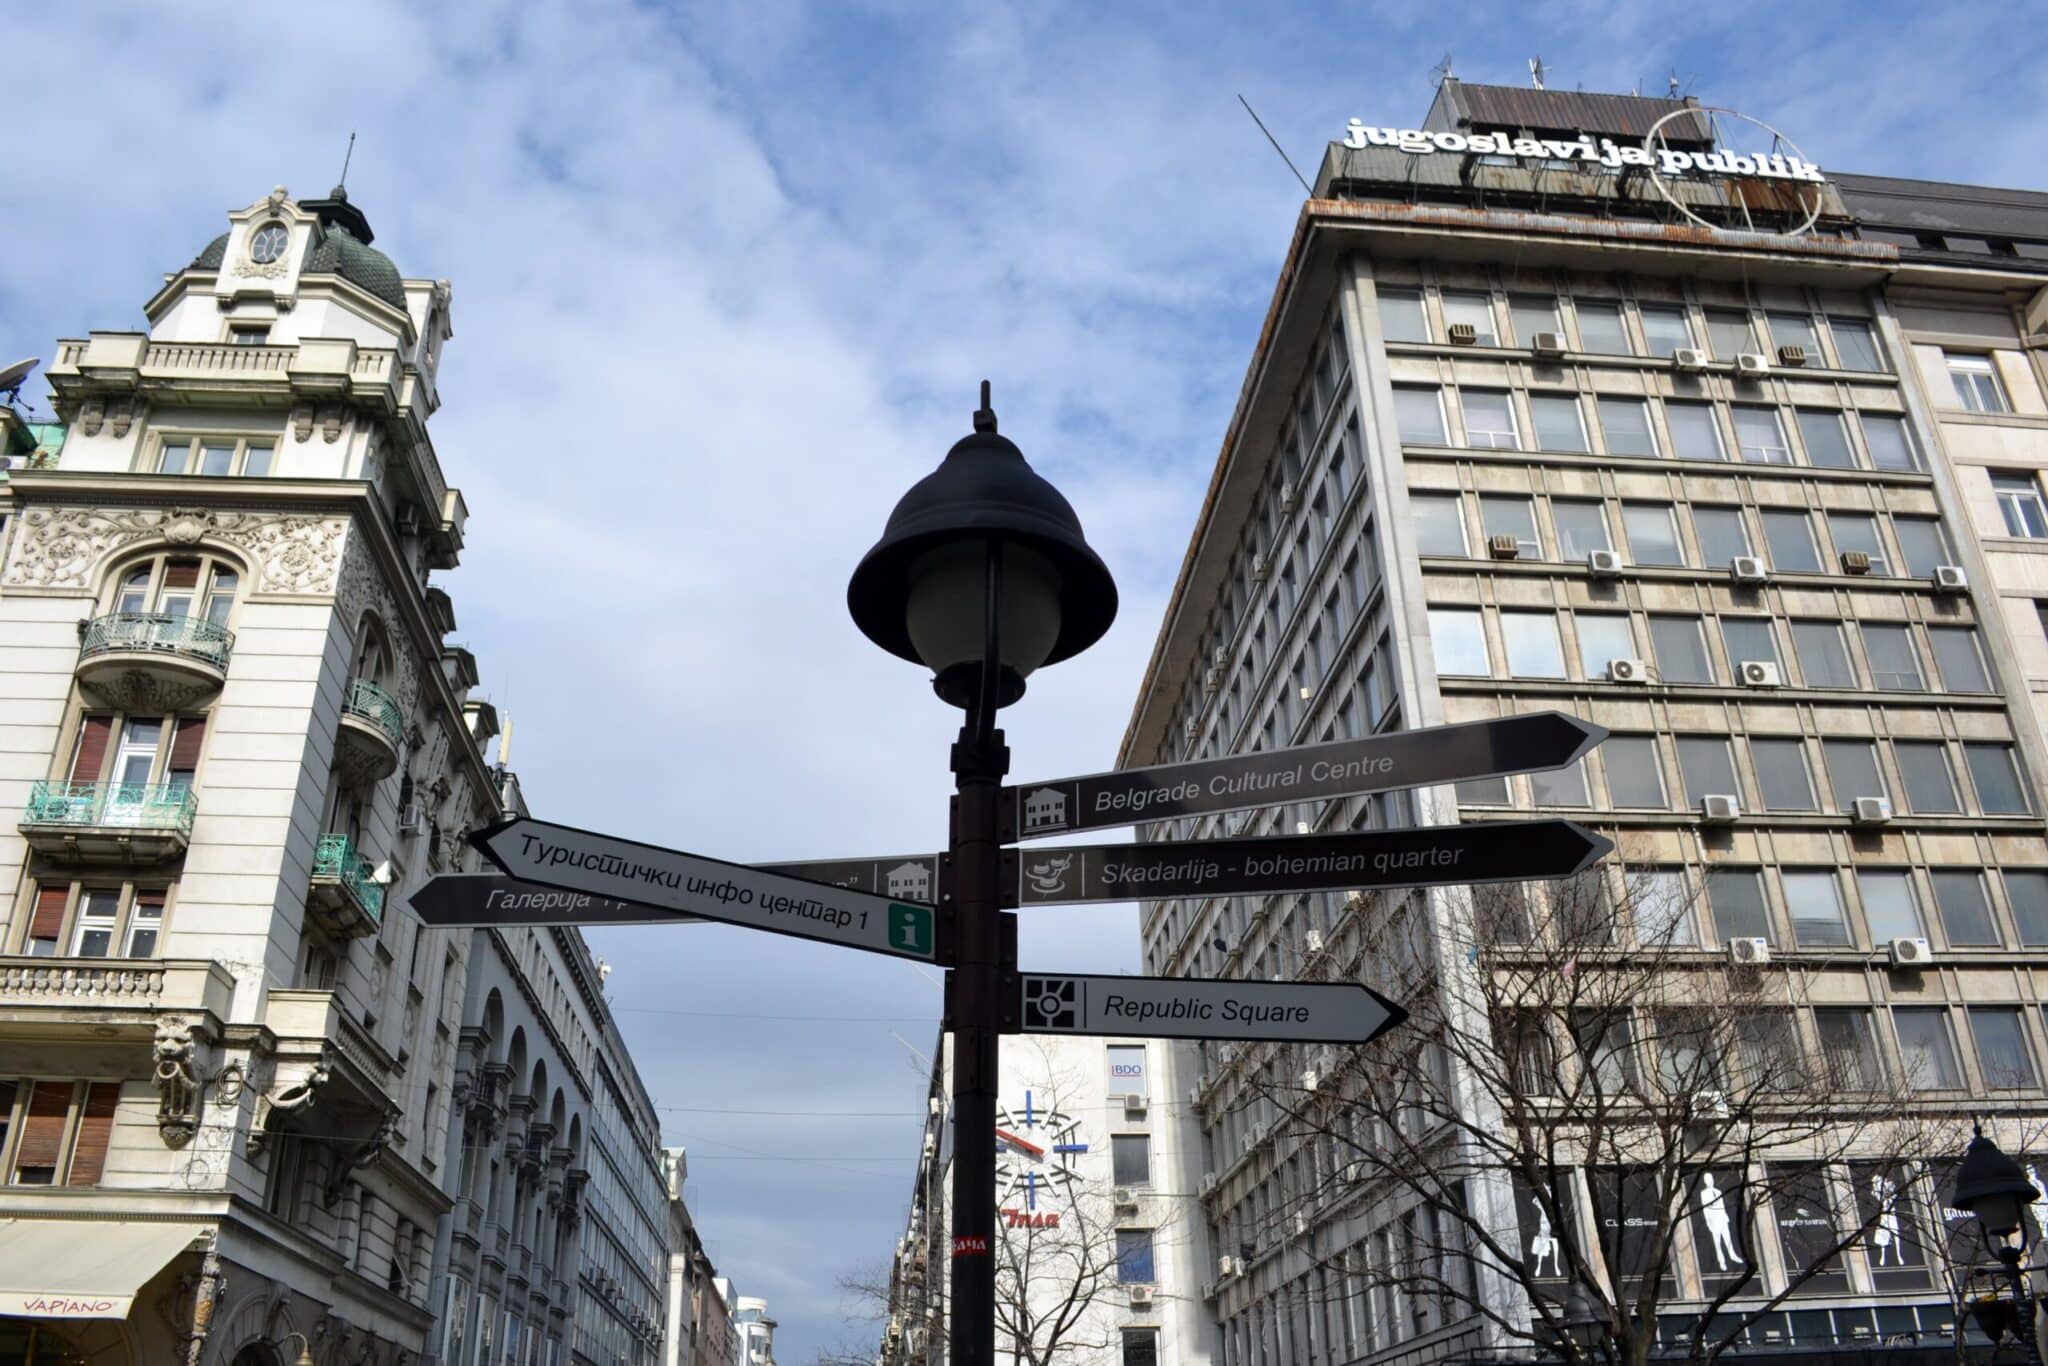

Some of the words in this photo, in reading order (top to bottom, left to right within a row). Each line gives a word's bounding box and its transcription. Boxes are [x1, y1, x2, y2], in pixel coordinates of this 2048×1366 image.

[1343, 117, 1656, 169] jugoslavija
[1657, 148, 1826, 183] publik
[1095, 781, 1200, 812] Belgrade
[1208, 765, 1303, 797] Cultural
[1310, 755, 1394, 782] Centre
[521, 833, 682, 889] Туристички
[687, 874, 754, 905] инфо
[760, 892, 852, 929] центар
[859, 911, 869, 930] 1
[1100, 857, 1219, 885] Skadarlija
[1244, 852, 1365, 877] bohemian
[1374, 845, 1465, 870] quarter
[485, 889, 592, 912] Галерија
[1104, 994, 1213, 1022] Republic
[1221, 999, 1310, 1027] Square
[1114, 1064, 1142, 1074] BDO
[24, 1298, 112, 1313] VAPIANO
